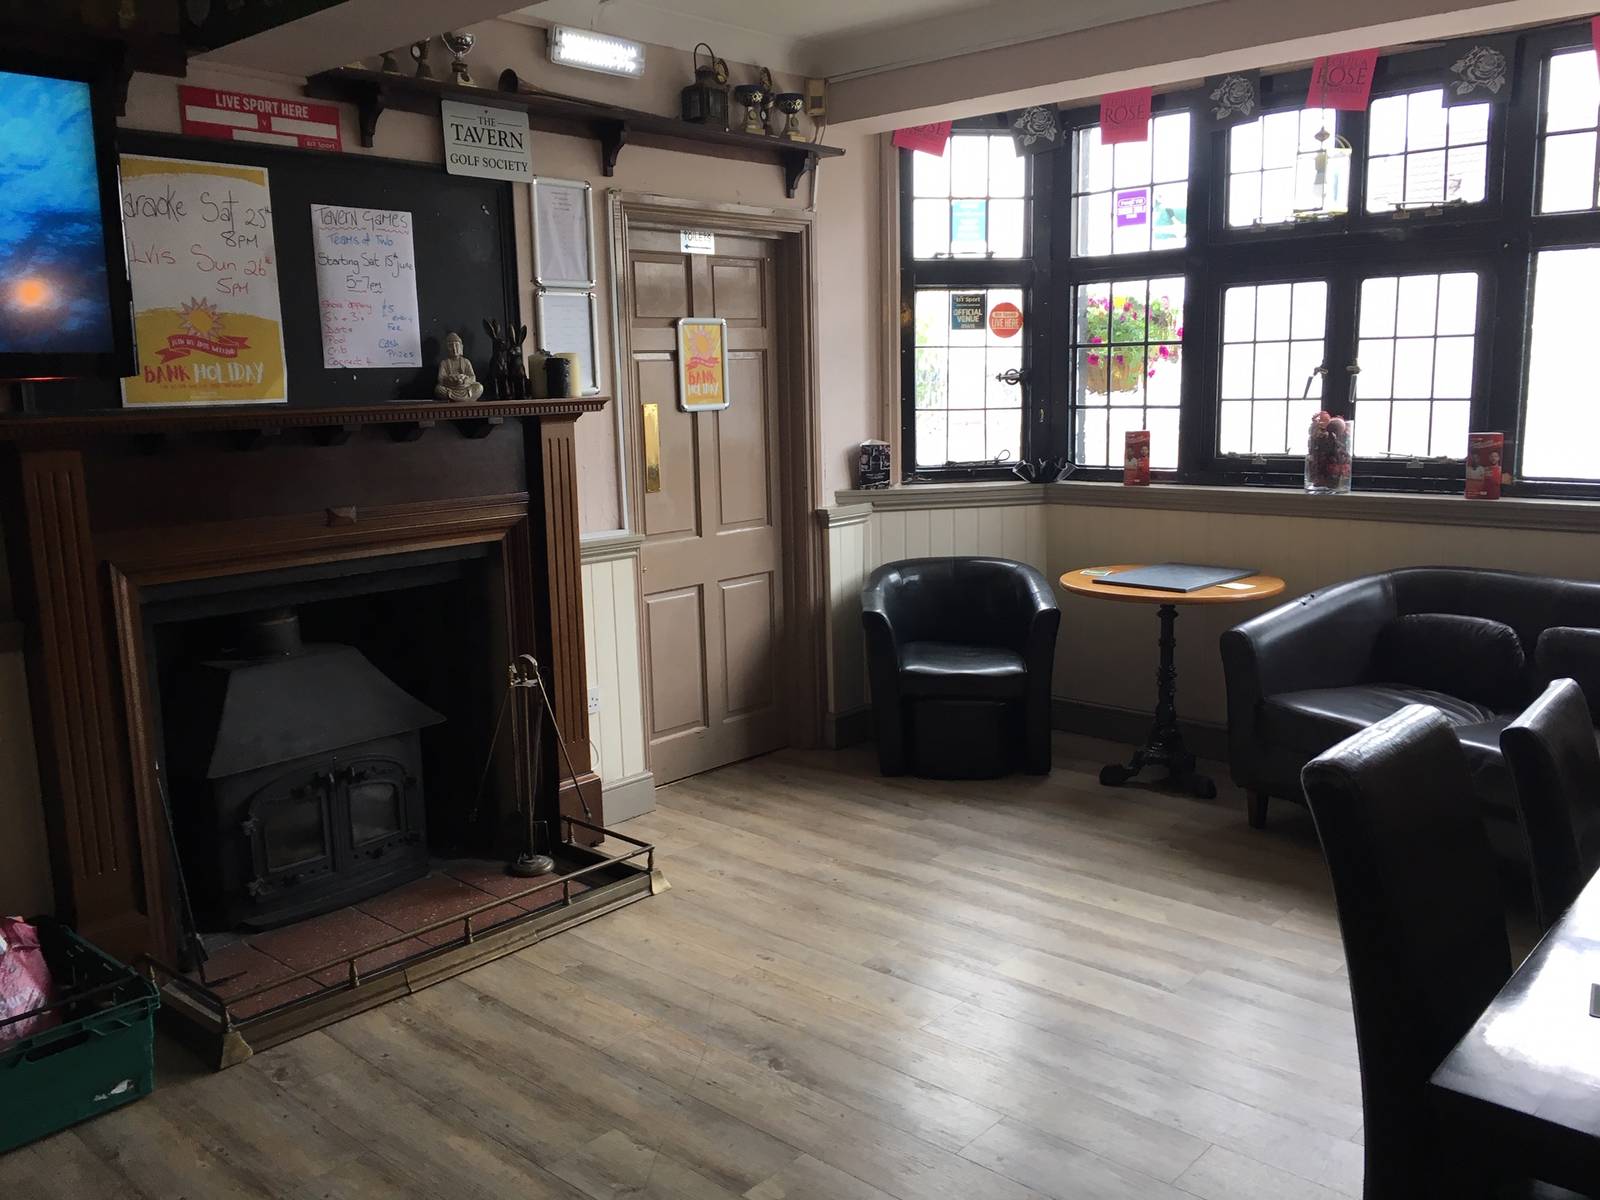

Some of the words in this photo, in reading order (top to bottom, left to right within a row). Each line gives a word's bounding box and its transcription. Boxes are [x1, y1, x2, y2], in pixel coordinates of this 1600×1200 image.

[215, 93, 241, 109] LIVE
[242, 97, 279, 114] SPORT
[281, 103, 309, 118] HERE
[1104, 104, 1146, 125] ROSE
[477, 116, 497, 127] THE
[450, 123, 524, 149] TAVERN
[450, 152, 480, 168] GOLF
[482, 156, 529, 172] SOCIETY
[199, 189, 240, 232] Sat
[190, 243, 237, 272] Sun
[318, 253, 360, 275] Starting
[361, 252, 381, 267] Sat
[953, 308, 983, 316] OFFICIAL
[956, 315, 980, 323] VENUE
[192, 361, 265, 384] HOLIDAY
[688, 370, 716, 384] BANK
